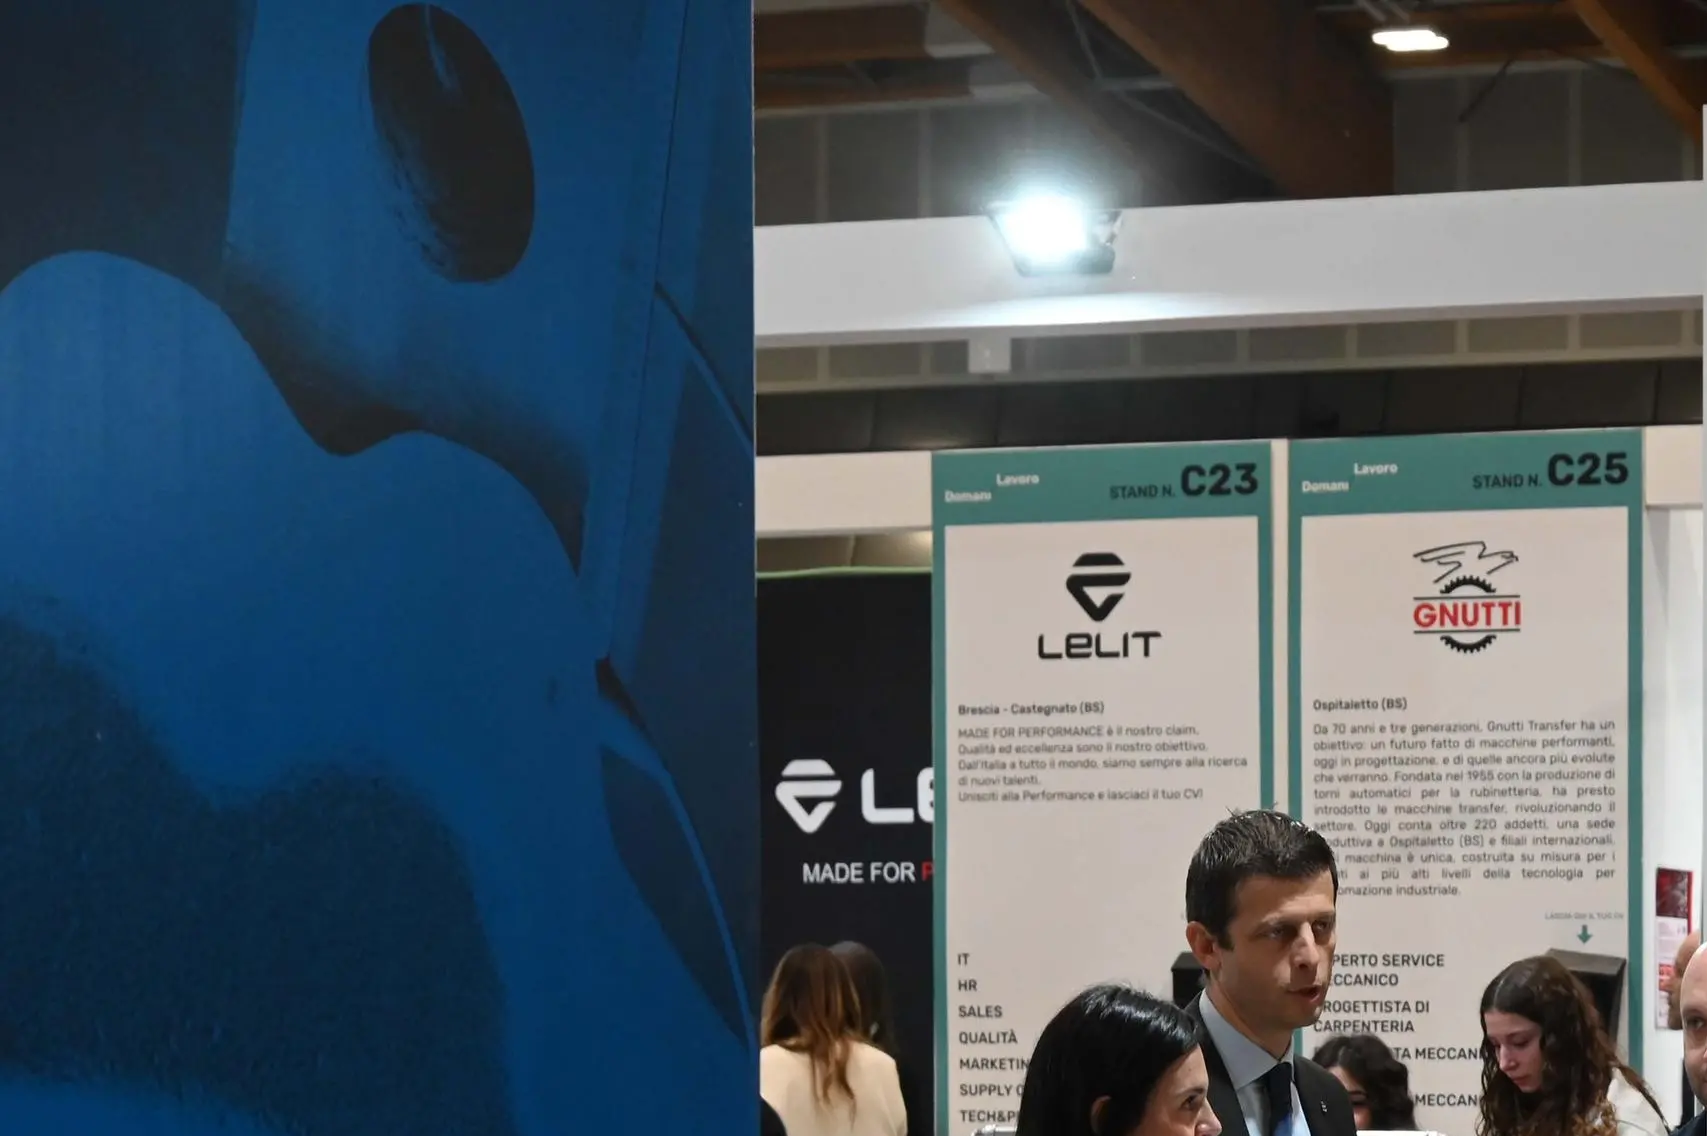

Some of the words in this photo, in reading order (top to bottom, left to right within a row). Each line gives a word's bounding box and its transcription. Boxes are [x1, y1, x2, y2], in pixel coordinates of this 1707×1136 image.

[1353, 462, 1398, 476] Lavoro
[1472, 474, 1524, 490] STAND
[1528, 472, 1543, 488] N.
[1547, 452, 1629, 486] C25
[996, 472, 1039, 487] Lavoro
[1109, 485, 1159, 501] STAND
[1180, 462, 1259, 498] C23
[1413, 602, 1522, 628] GNUTTI
[958, 704, 1000, 715] Brescia
[1010, 702, 1077, 717] Castegnato
[1079, 701, 1105, 715] (BS)
[1313, 699, 1379, 712] Ospitaletto
[1381, 697, 1408, 712] (BS)
[958, 728, 990, 739] MADE
[993, 727, 1015, 738] FOR
[1018, 725, 1104, 738] PERFORMANCE
[1332, 723, 1346, 734] 70
[1487, 720, 1524, 732] Gnutti
[1528, 720, 1577, 731] Transfer
[1390, 739, 1427, 750] futuro
[1431, 737, 1460, 749] fatto
[1480, 737, 1537, 748] macchine
[1506, 755, 1546, 765] ancora
[1571, 751, 1616, 763] evolute
[1394, 770, 1443, 782] Fondata
[1535, 768, 1601, 782] produzione
[1349, 786, 1412, 799] automatici
[1577, 784, 1616, 798] presto
[1314, 803, 1371, 815] introdotto
[1394, 803, 1452, 814] macchine
[1515, 801, 1602, 813] rivoluzionando
[1364, 820, 1390, 834] Oggi
[1398, 819, 1432, 831] conta
[1474, 818, 1497, 830] 220
[1586, 817, 1616, 829] sede
[1389, 834, 1454, 849] Ospitaletto
[1459, 833, 1484, 848] (BS)
[1345, 850, 1401, 863] macchina
[1462, 850, 1514, 862] costruita
[1541, 850, 1581, 861] misura
[802, 862, 864, 884] MADE
[870, 861, 915, 883] FOR
[1483, 867, 1510, 879] della
[1522, 865, 1583, 881] tecnologia
[957, 953, 970, 966] IT
[1382, 953, 1445, 967] SERVICE
[958, 979, 977, 992] HR
[958, 1005, 1003, 1018] SALES
[1321, 1000, 1412, 1014] ROGETTISTA
[1415, 999, 1430, 1013] DI
[1314, 1019, 1415, 1034] CARPENTERIA
[959, 1029, 1018, 1045] QUALITÀ
[959, 1058, 1030, 1071] MARKETIN
[959, 1083, 1013, 1097] SUPPLY
[1414, 1093, 1478, 1107] MECCAN
[960, 1110, 1020, 1123] TECH&P
